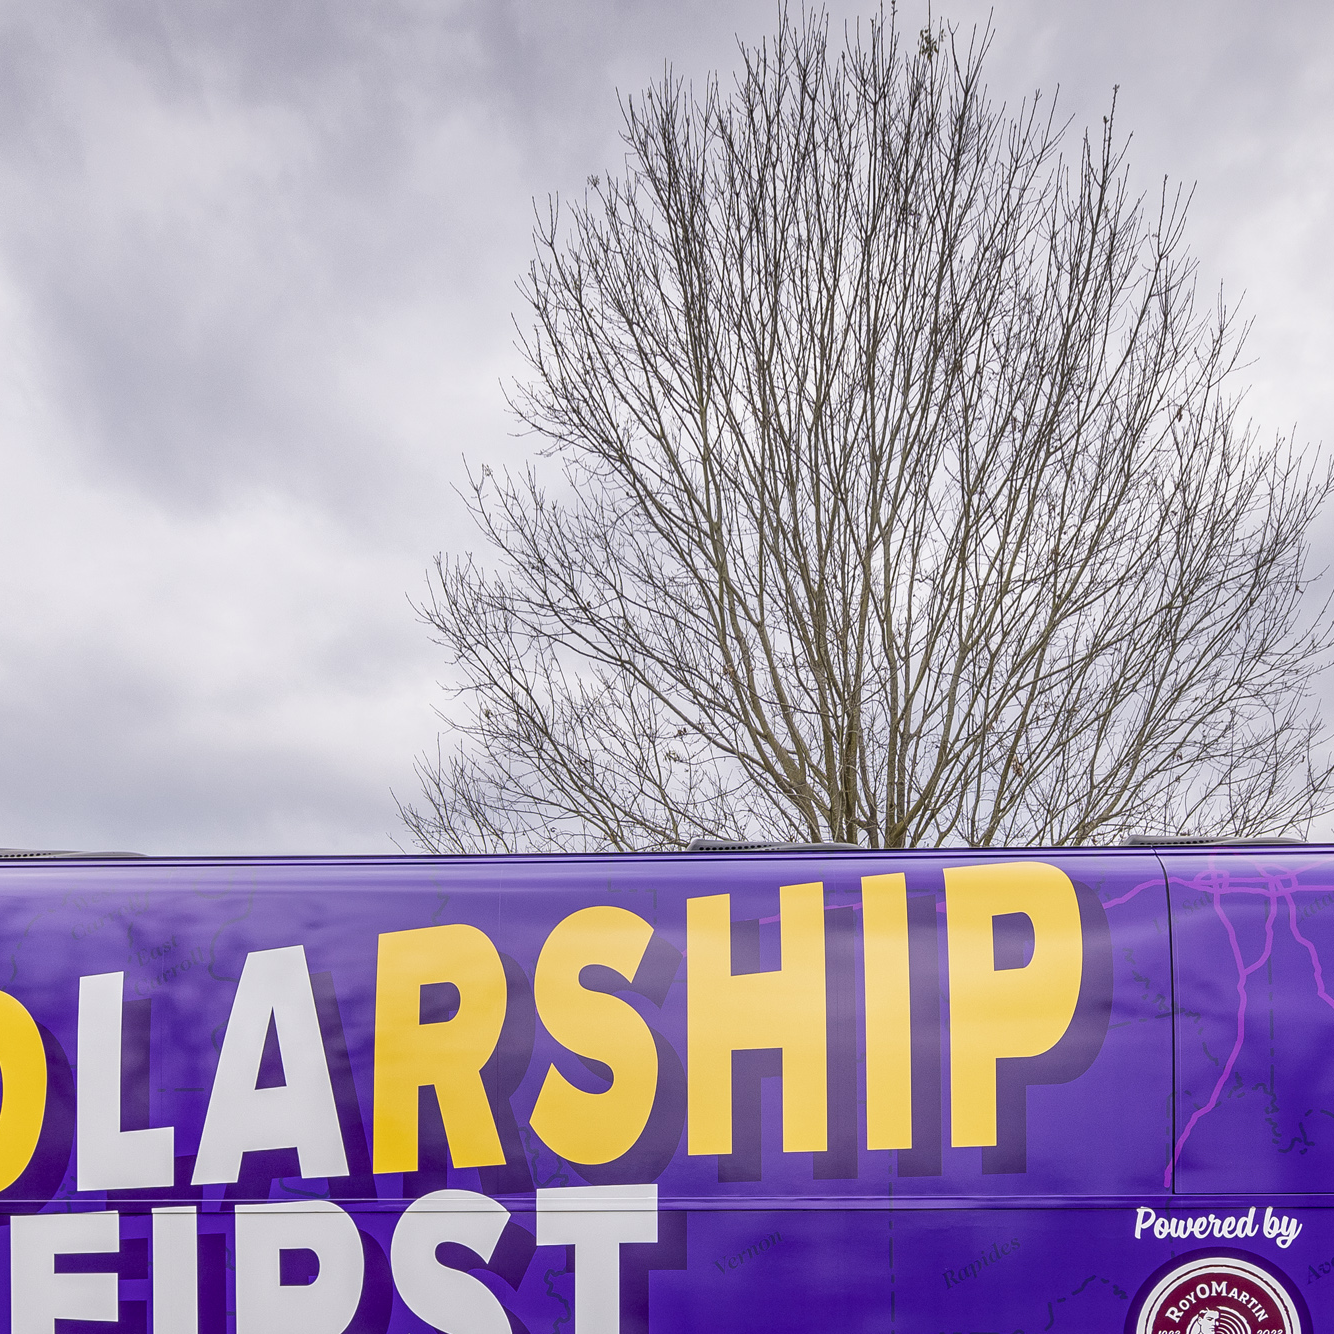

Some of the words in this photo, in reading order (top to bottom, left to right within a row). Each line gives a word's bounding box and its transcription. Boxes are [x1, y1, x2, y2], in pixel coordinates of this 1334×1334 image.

[713, 1227, 786, 1277] Vernon
[1134, 1206, 1259, 1239] Powered
[1263, 1206, 1303, 1249] by
[942, 1234, 1023, 1290] Rapides
